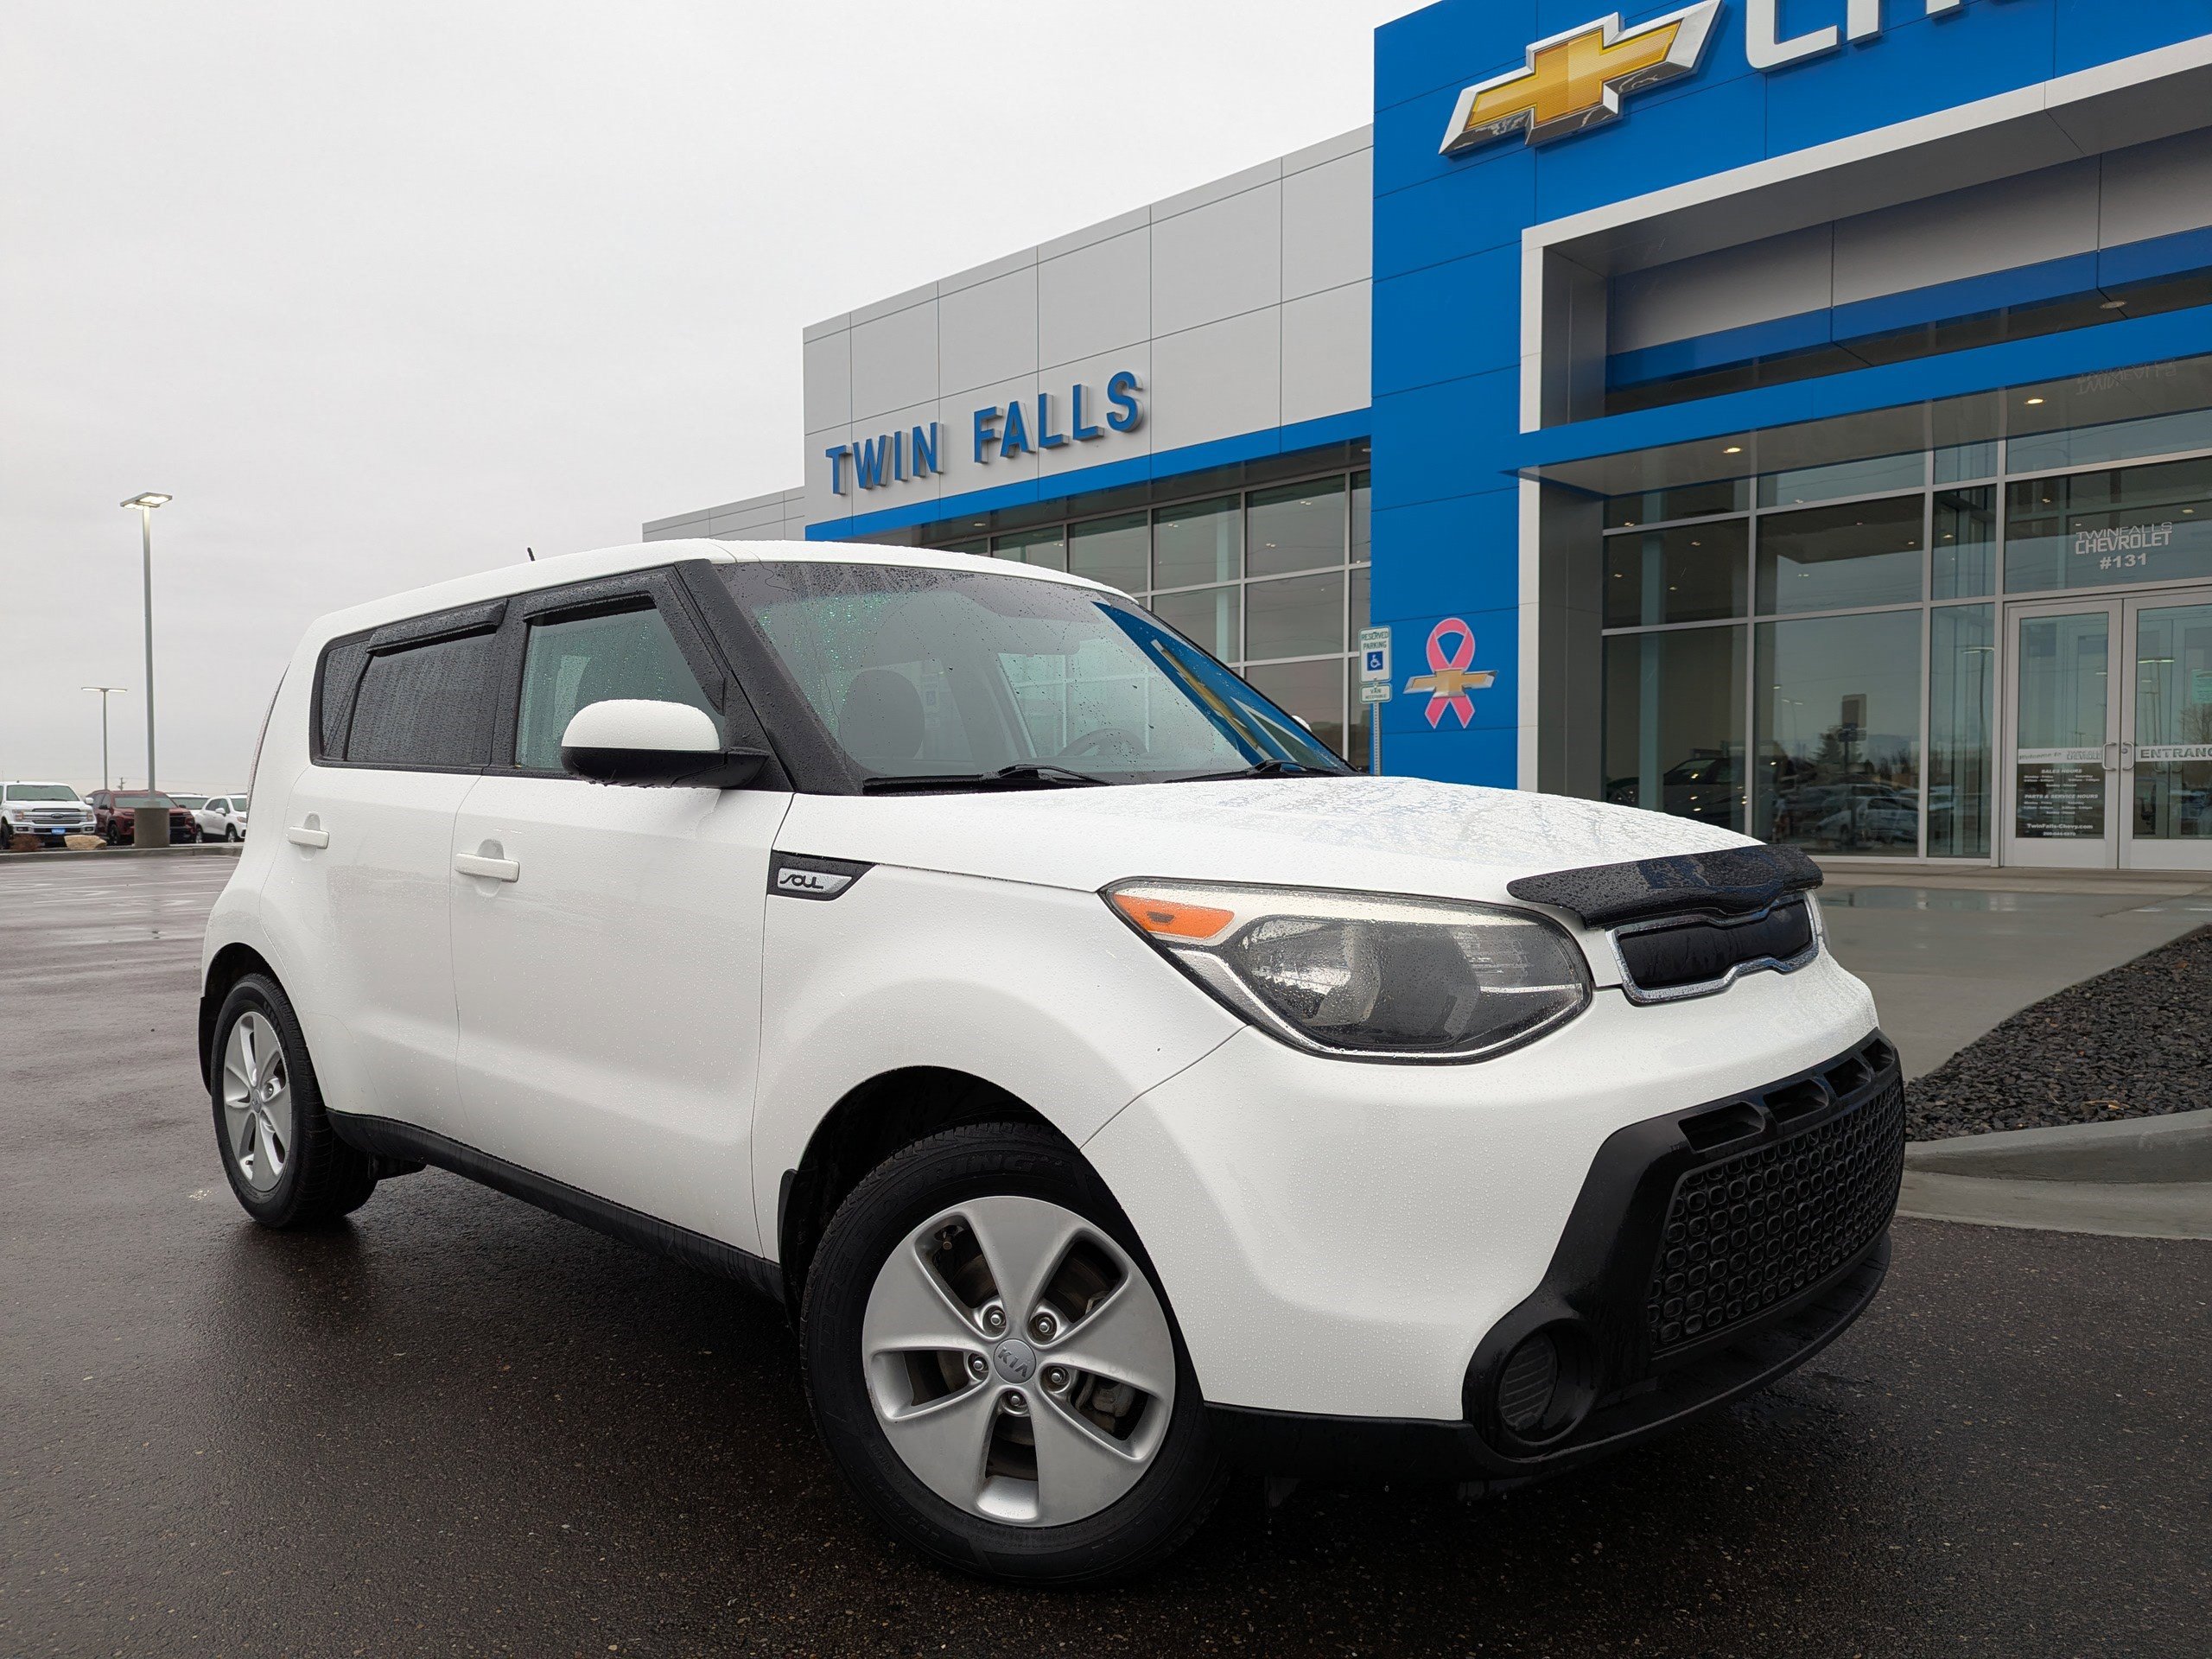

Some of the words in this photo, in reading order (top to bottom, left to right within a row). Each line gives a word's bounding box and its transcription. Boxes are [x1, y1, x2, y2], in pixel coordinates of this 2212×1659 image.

[826, 422, 944, 495] TWIN
[973, 371, 1144, 464] FALLS
[2075, 530, 2173, 555] CHEVROLET
[2099, 552, 2147, 570] #131
[1361, 631, 1389, 641] RESERVED
[1363, 641, 1387, 650] PARKING
[779, 874, 824, 890] SOUL
[997, 1346, 1029, 1378] KIA
